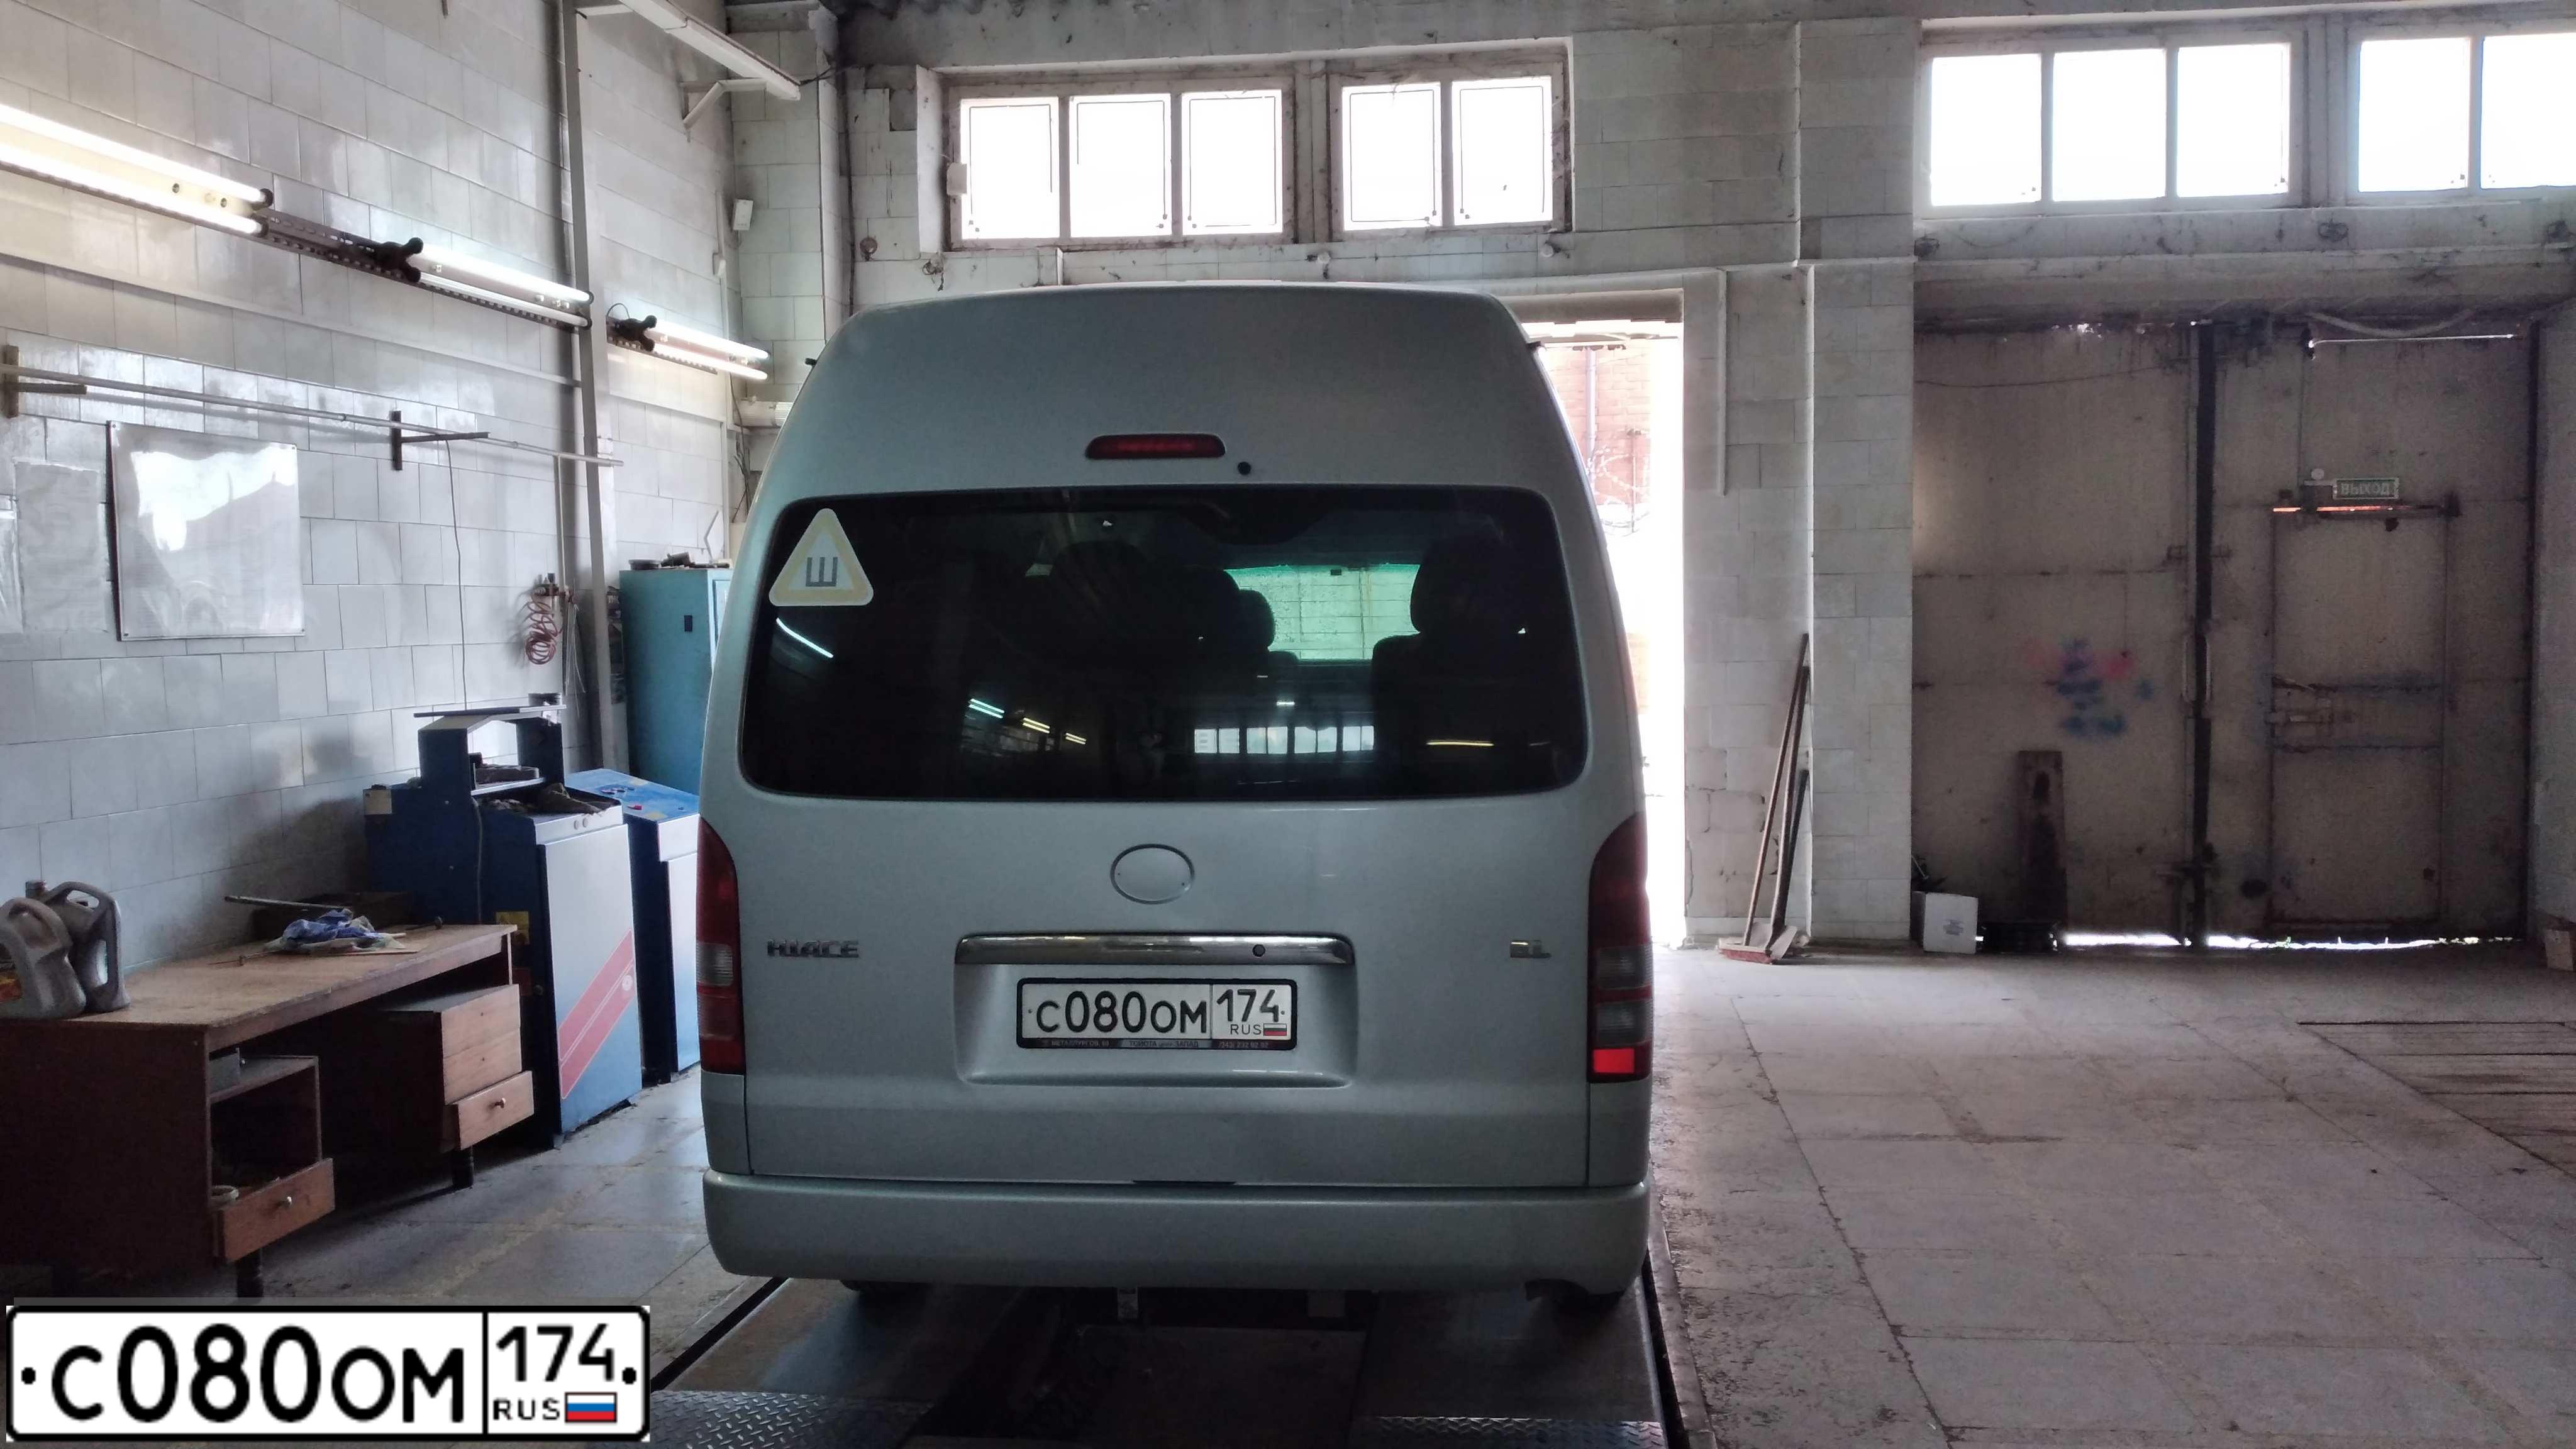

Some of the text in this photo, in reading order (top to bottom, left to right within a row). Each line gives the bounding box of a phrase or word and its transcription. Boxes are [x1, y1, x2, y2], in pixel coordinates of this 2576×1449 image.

[2341, 482, 2390, 496] ВЫХОД
[806, 557, 838, 587] Ш
[1216, 989, 1279, 1023] 174
[1230, 1024, 1262, 1035] RUS
